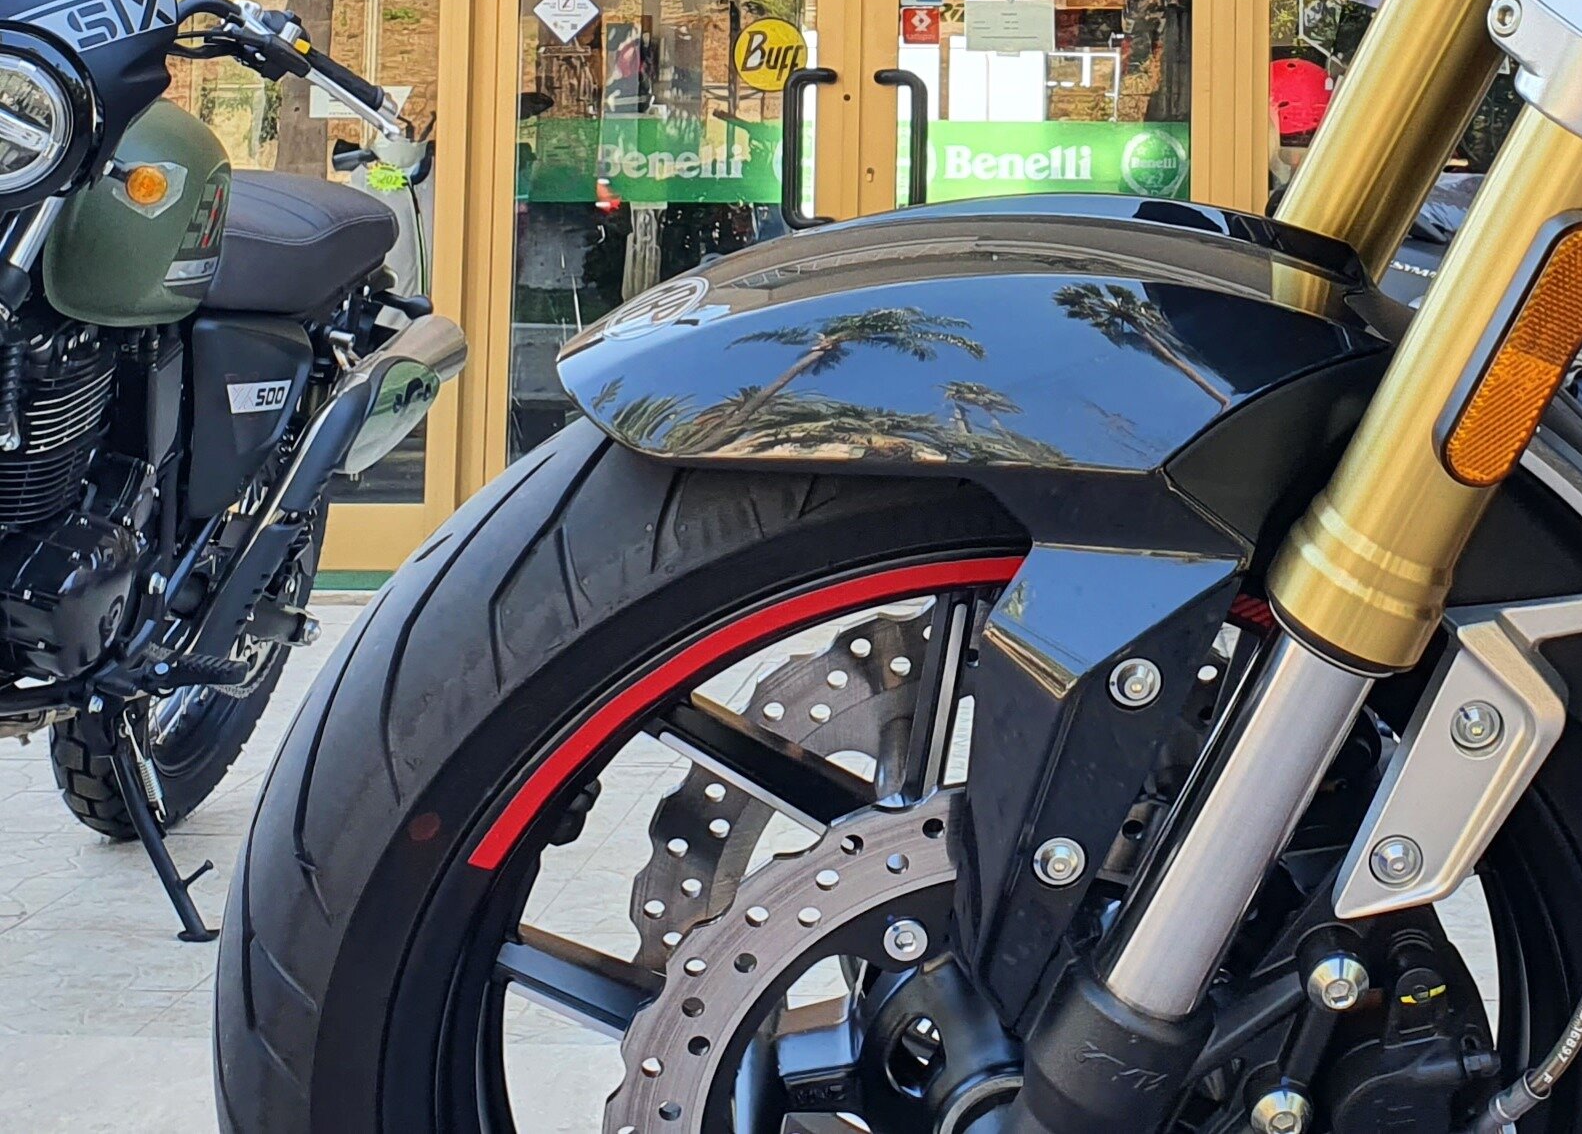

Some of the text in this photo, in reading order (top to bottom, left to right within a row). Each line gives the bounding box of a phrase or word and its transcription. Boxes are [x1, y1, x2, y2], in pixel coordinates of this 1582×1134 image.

[593, 143, 743, 179] Benelli
[944, 145, 1092, 180] Benelli
[255, 386, 285, 407] 500
